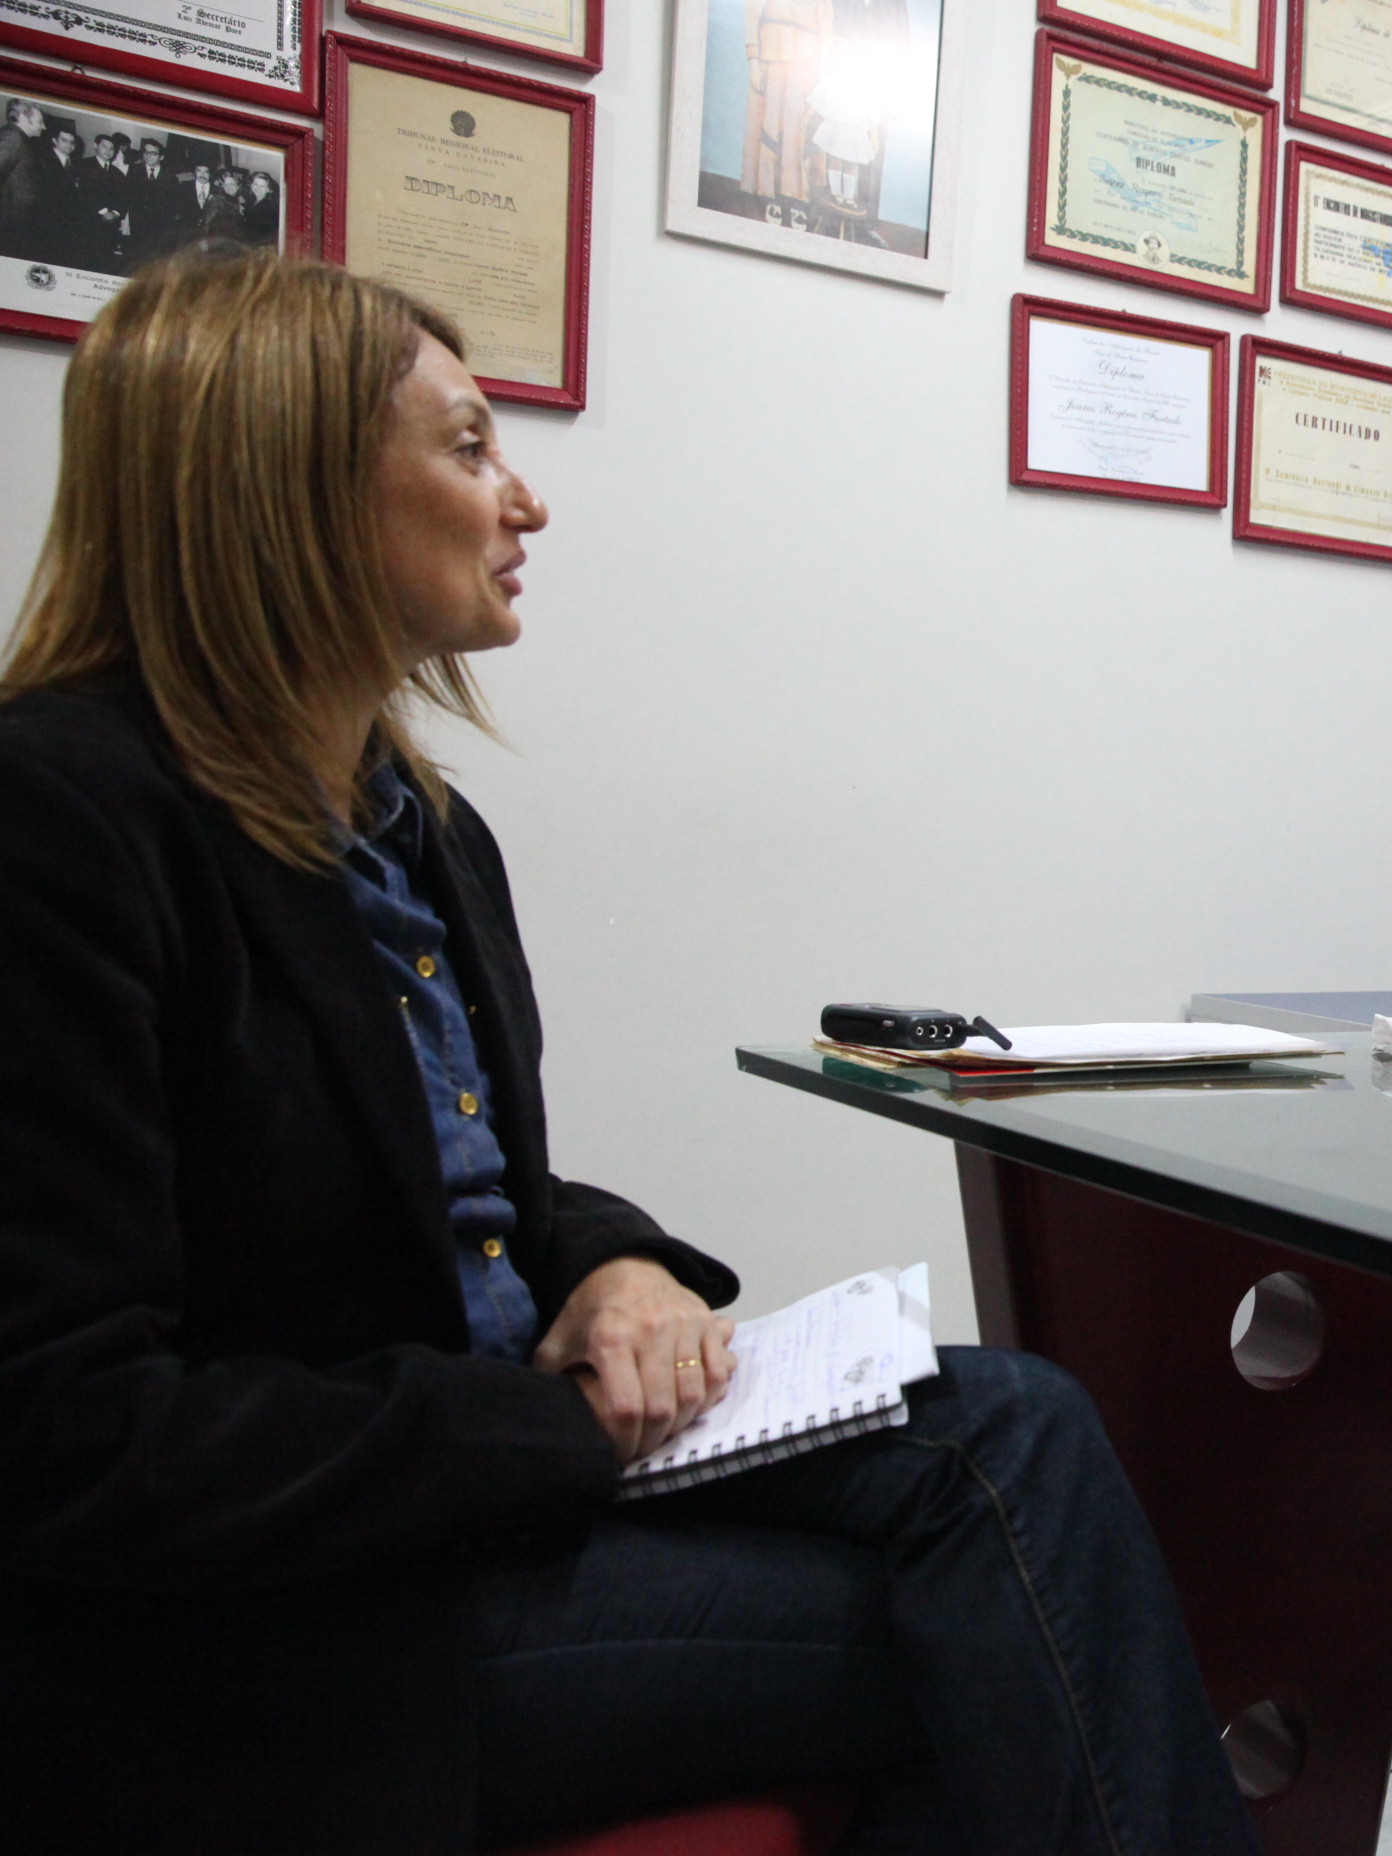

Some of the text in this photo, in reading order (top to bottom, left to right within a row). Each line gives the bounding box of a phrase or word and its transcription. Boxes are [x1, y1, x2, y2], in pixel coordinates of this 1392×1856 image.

[196, 8, 247, 29] Secretário
[396, 127, 525, 162] TRIBUNAL REGIONAL ELEITORAL
[418, 143, 506, 167] SANTA CATARINA
[1136, 157, 1176, 178] DIPLOMA
[404, 175, 517, 212] DIPLOMA
[76, 273, 109, 284] Encontro
[1098, 359, 1145, 382] Diploma
[1057, 397, 1095, 413] Juarez
[1142, 408, 1183, 426] Furtado
[1295, 412, 1381, 442] CERTIFICADO
